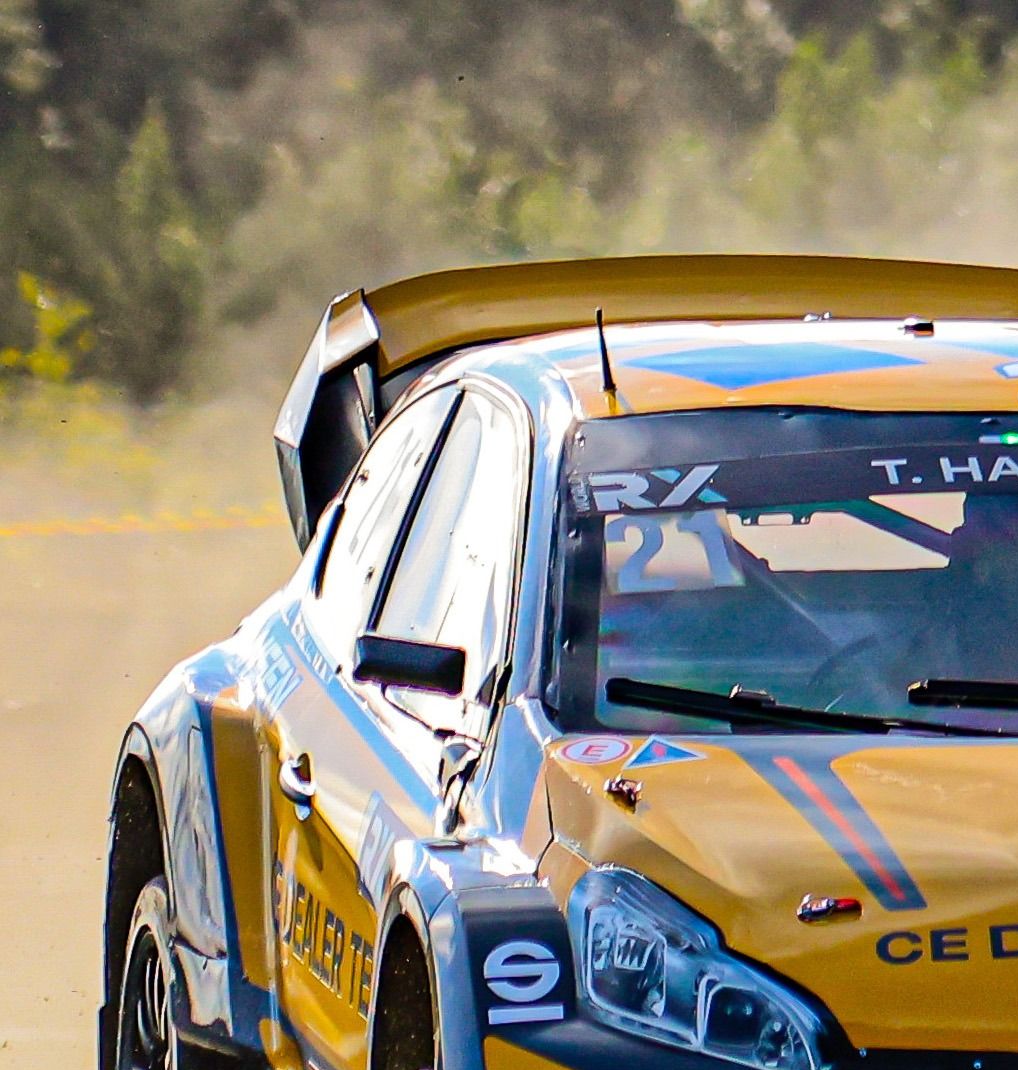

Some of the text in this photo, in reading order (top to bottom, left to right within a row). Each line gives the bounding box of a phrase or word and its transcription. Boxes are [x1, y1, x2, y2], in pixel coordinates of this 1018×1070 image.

[588, 464, 729, 512] RX
[870, 458, 922, 485] T.
[606, 510, 737, 593] 21
[875, 930, 969, 966] CE
